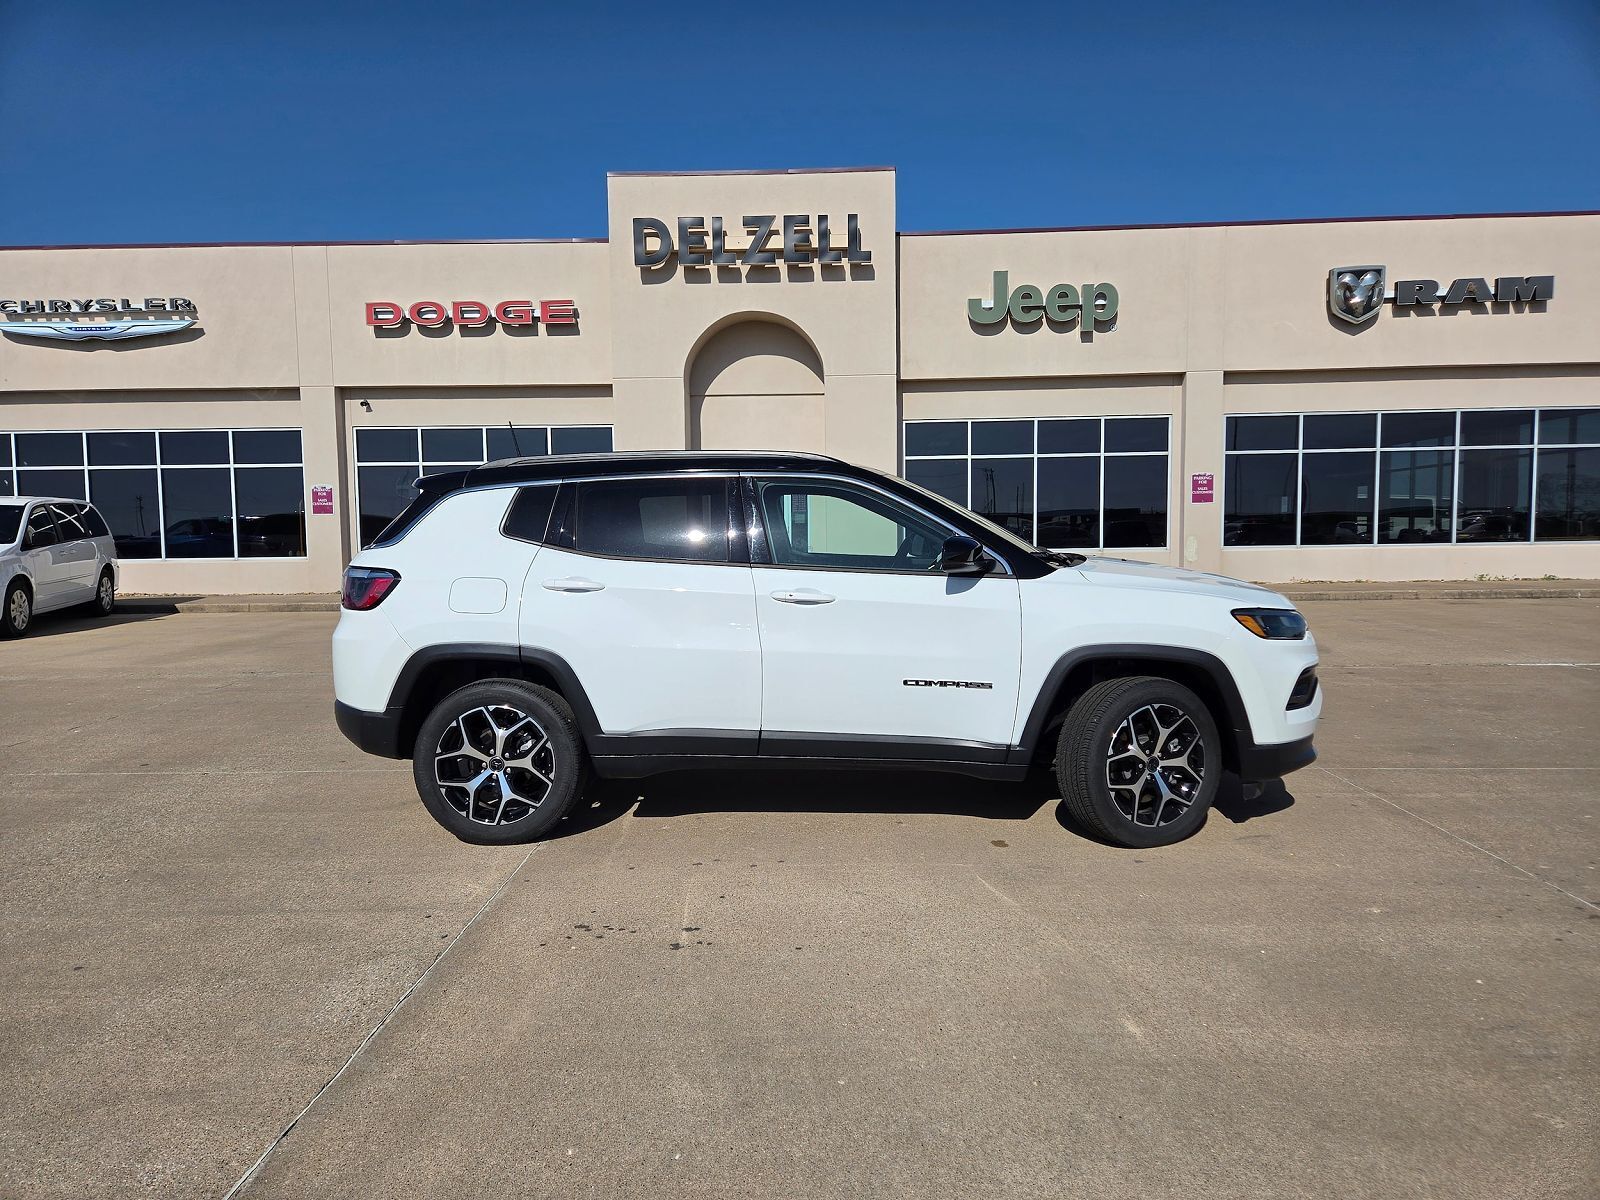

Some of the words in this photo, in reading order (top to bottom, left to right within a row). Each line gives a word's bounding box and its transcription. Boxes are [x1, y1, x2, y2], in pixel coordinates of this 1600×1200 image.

[633, 214, 872, 266] DELZELL
[968, 271, 1119, 332] Jeep
[1396, 275, 1554, 305] RAM
[0, 297, 196, 314] CHRYSLER
[365, 300, 576, 326] DODGE
[902, 679, 993, 690] COMPASS
